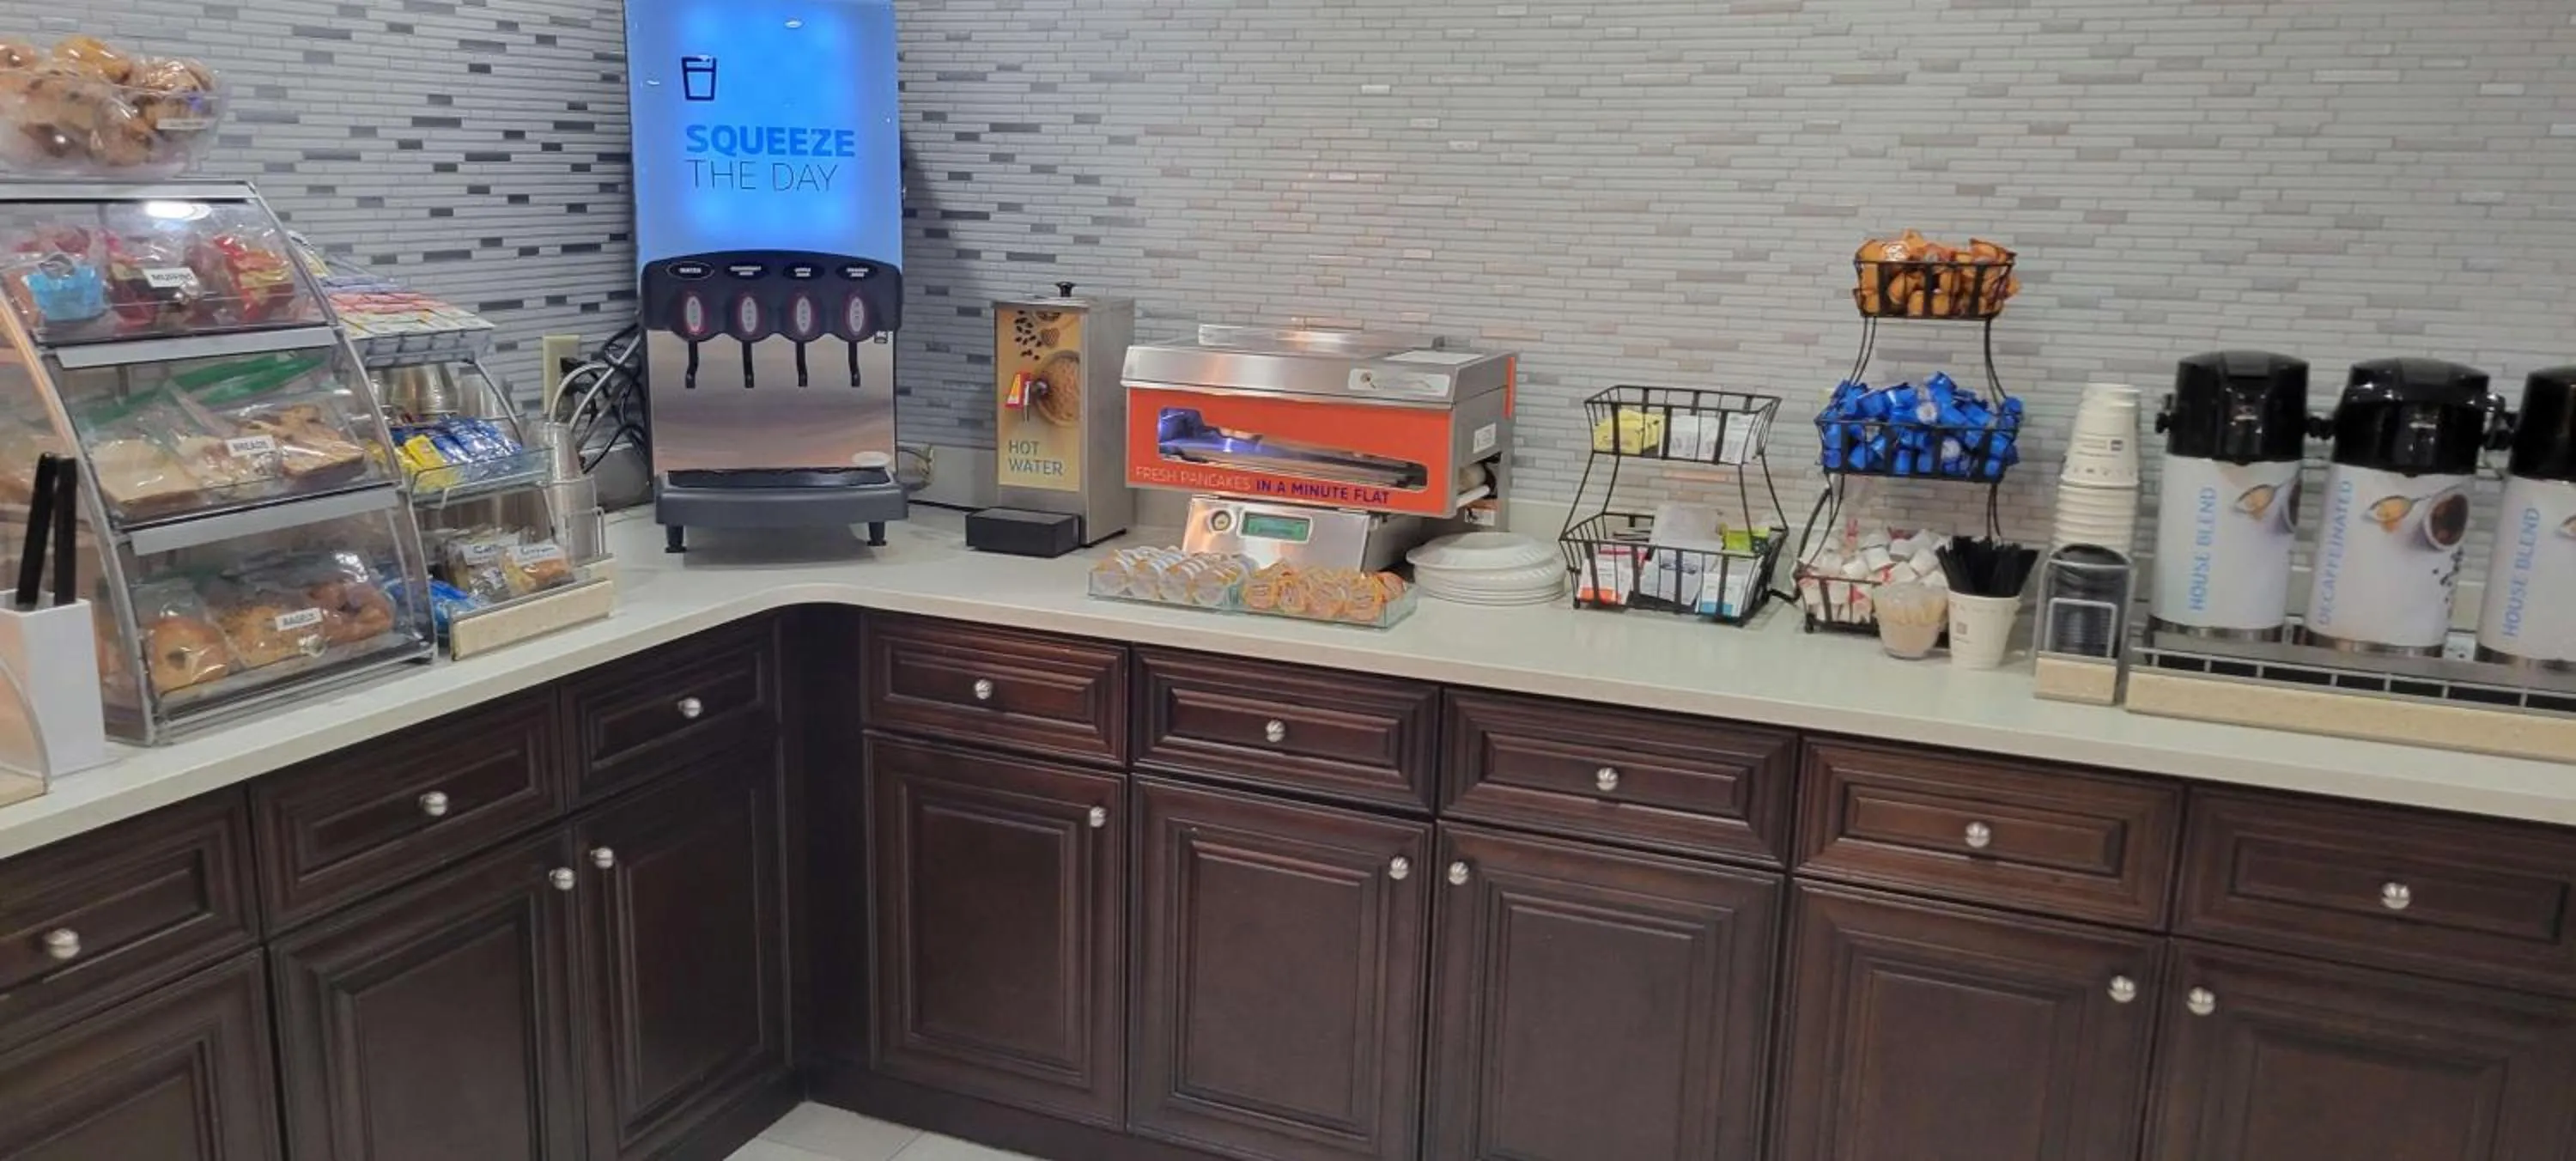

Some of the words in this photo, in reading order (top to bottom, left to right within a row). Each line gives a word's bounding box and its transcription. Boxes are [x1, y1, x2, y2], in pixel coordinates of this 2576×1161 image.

[686, 125, 855, 157] SQUEEZE
[685, 159, 756, 189] THE
[773, 161, 838, 192] DAY
[1008, 439, 1040, 455] HOT
[1008, 458, 1064, 477] WATER
[1135, 466, 1176, 483] FRESH
[1181, 471, 1251, 490] PANCAKES
[1256, 480, 1272, 492] IN
[1277, 482, 1286, 493] A
[1291, 483, 1348, 500] MINUTE
[1354, 488, 1390, 504] FLAT
[2196, 486, 2217, 546] BLEND
[2514, 508, 2540, 570] BLEND
[2318, 480, 2353, 626] DECAFFEINATED
[2188, 552, 2211, 611] HOUSE
[2502, 577, 2529, 637] HOUSE
